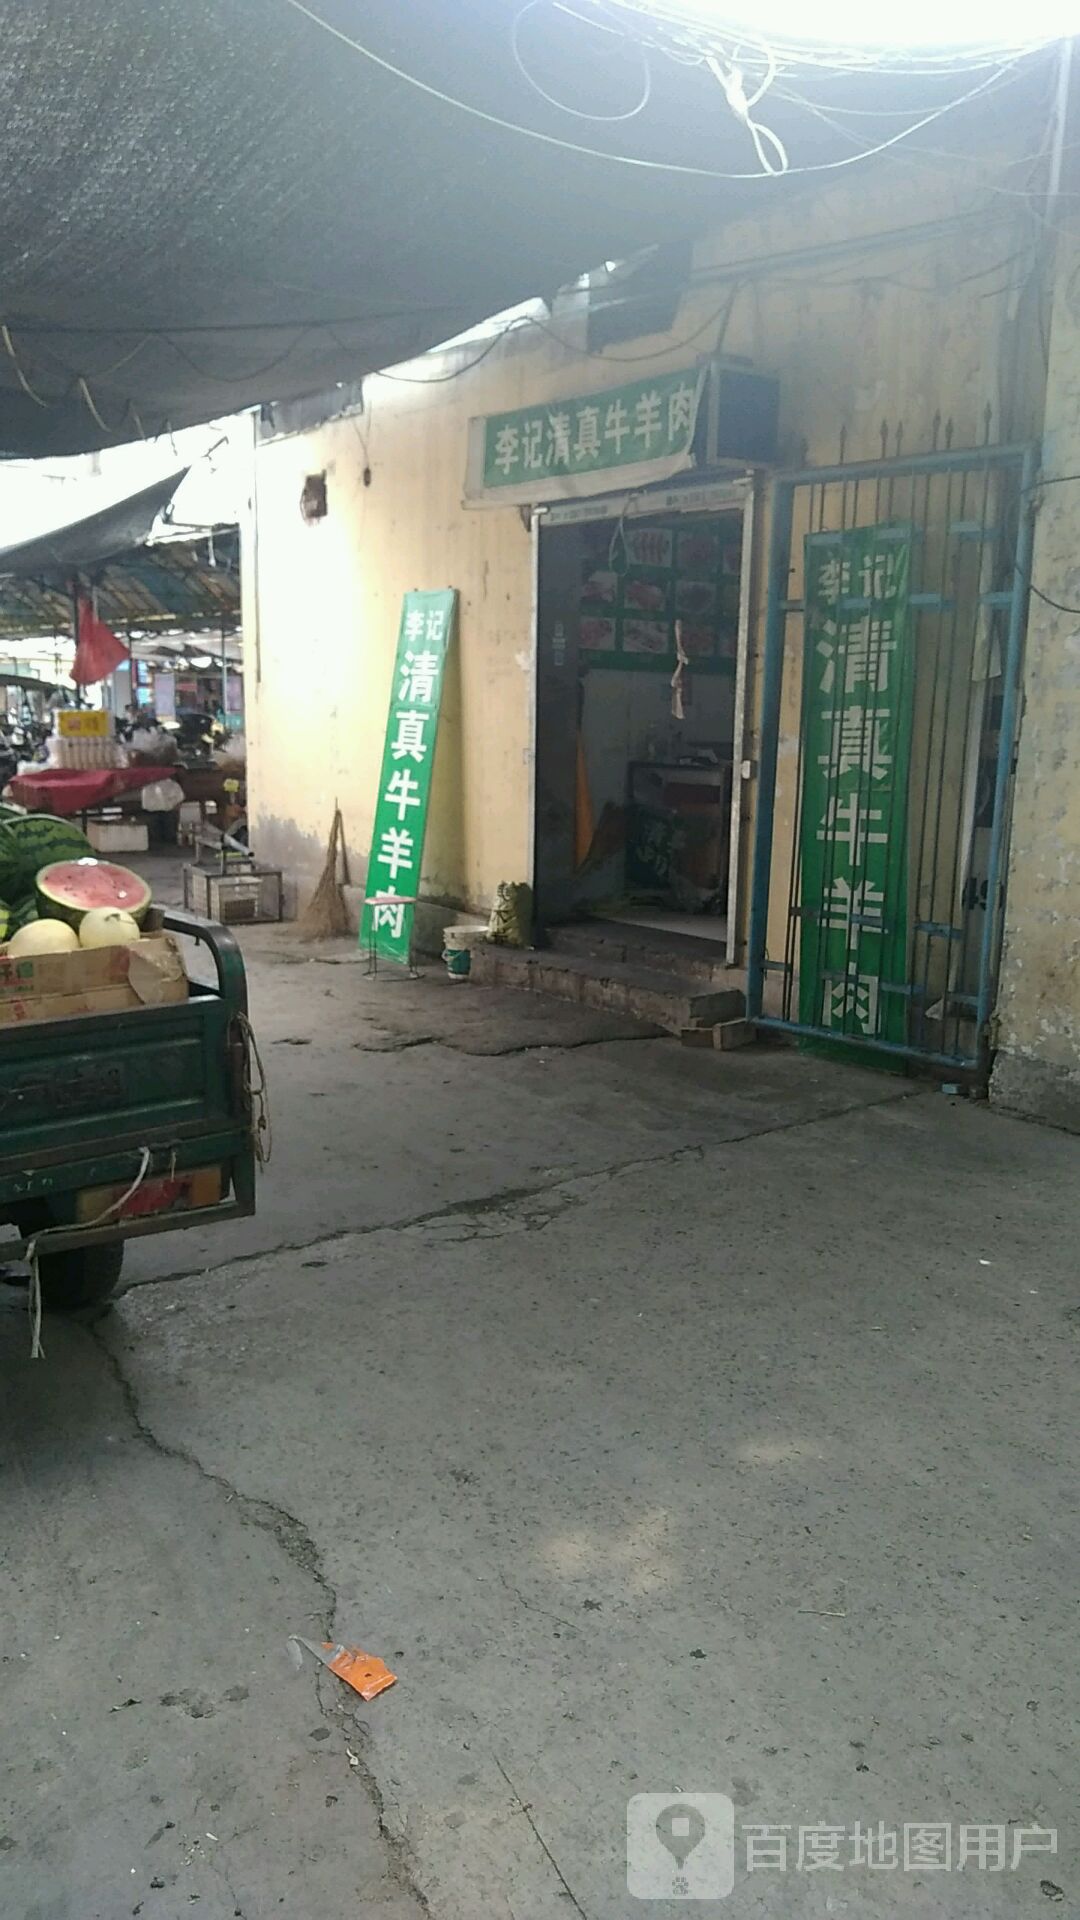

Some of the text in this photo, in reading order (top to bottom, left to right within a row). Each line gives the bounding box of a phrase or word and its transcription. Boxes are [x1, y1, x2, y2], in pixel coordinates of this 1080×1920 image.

[494, 382, 695, 475] 李记清真牛羊肉
[404, 609, 445, 642] 李记
[371, 649, 440, 938] 清真牛羊肉
[816, 614, 898, 1036] 清真牛羊肉
